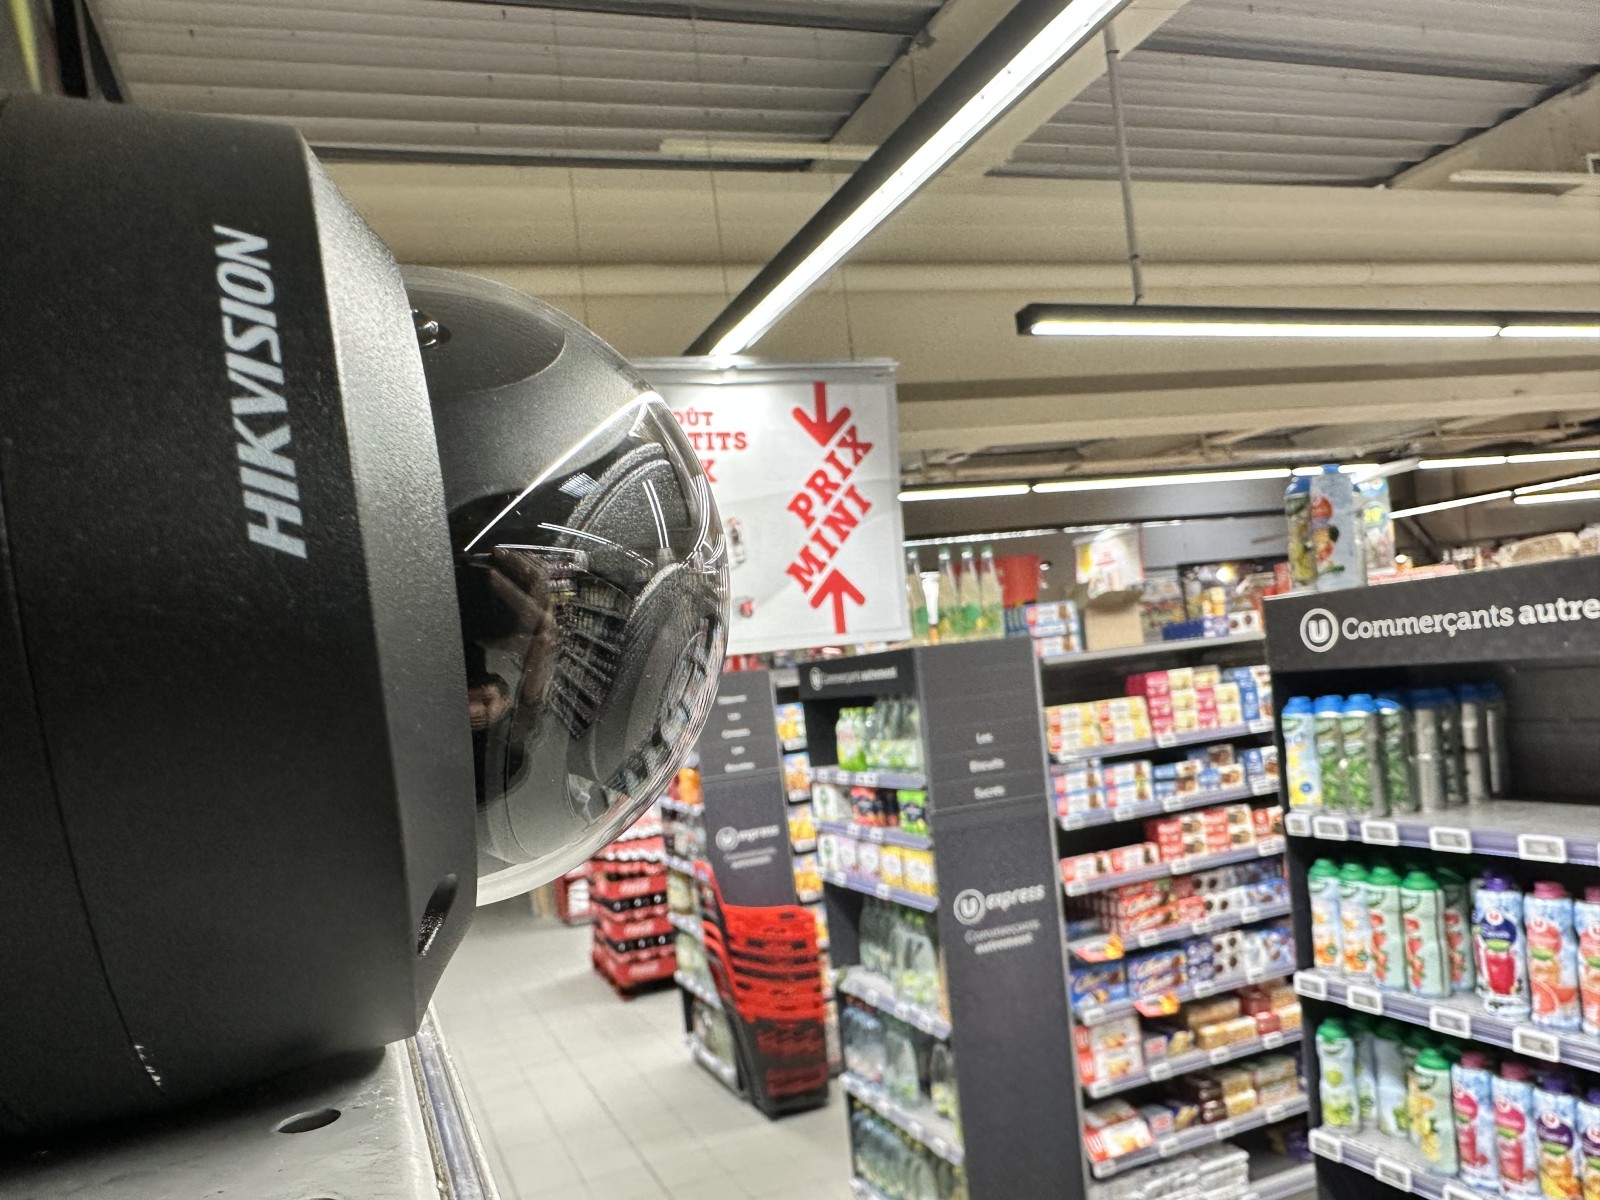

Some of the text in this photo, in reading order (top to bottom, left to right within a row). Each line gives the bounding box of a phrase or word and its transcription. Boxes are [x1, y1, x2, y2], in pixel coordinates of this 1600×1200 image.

[213, 224, 307, 559] HIKVISION
[673, 407, 714, 427] OÛT
[687, 431, 747, 451] TITS
[787, 424, 874, 529] PRIX
[785, 484, 873, 592] MINI
[1342, 604, 1514, 640] Commerçants
